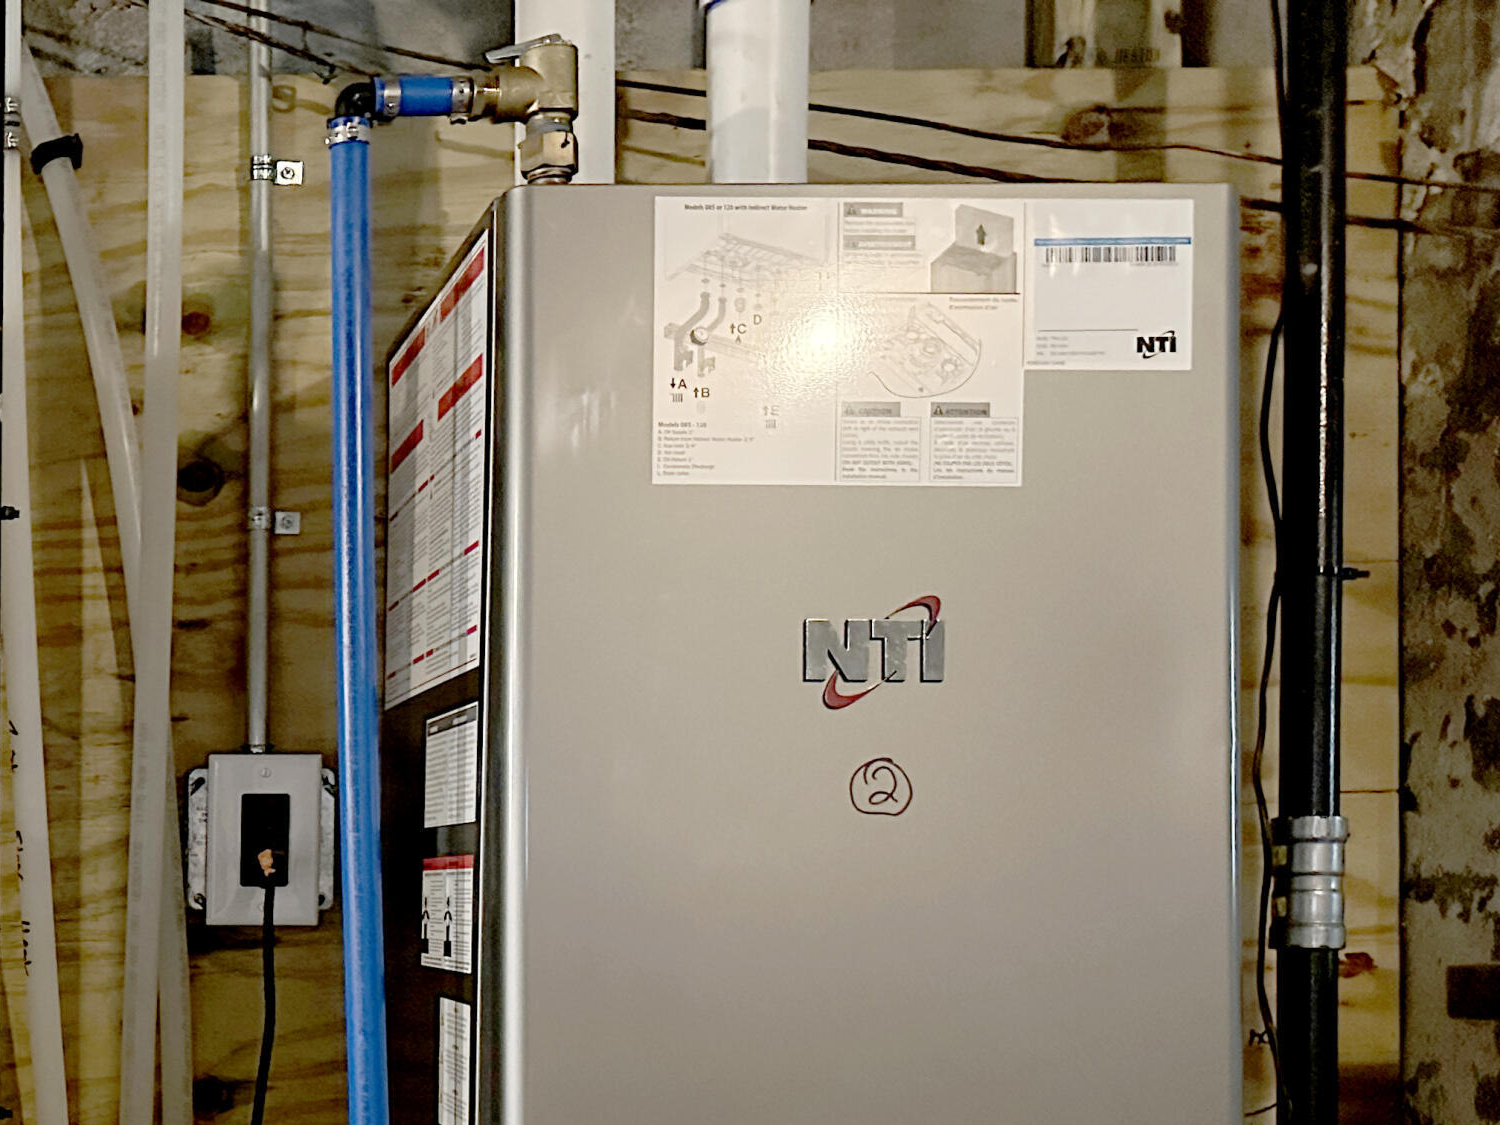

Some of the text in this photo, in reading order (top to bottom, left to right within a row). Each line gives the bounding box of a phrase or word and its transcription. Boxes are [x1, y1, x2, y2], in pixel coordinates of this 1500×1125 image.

[753, 314, 762, 325] D
[737, 323, 747, 334] C
[1136, 336, 1176, 353] NTI
[678, 379, 687, 389] A
[701, 387, 710, 398] B
[803, 618, 945, 683] NTI
[868, 765, 898, 806] 2
